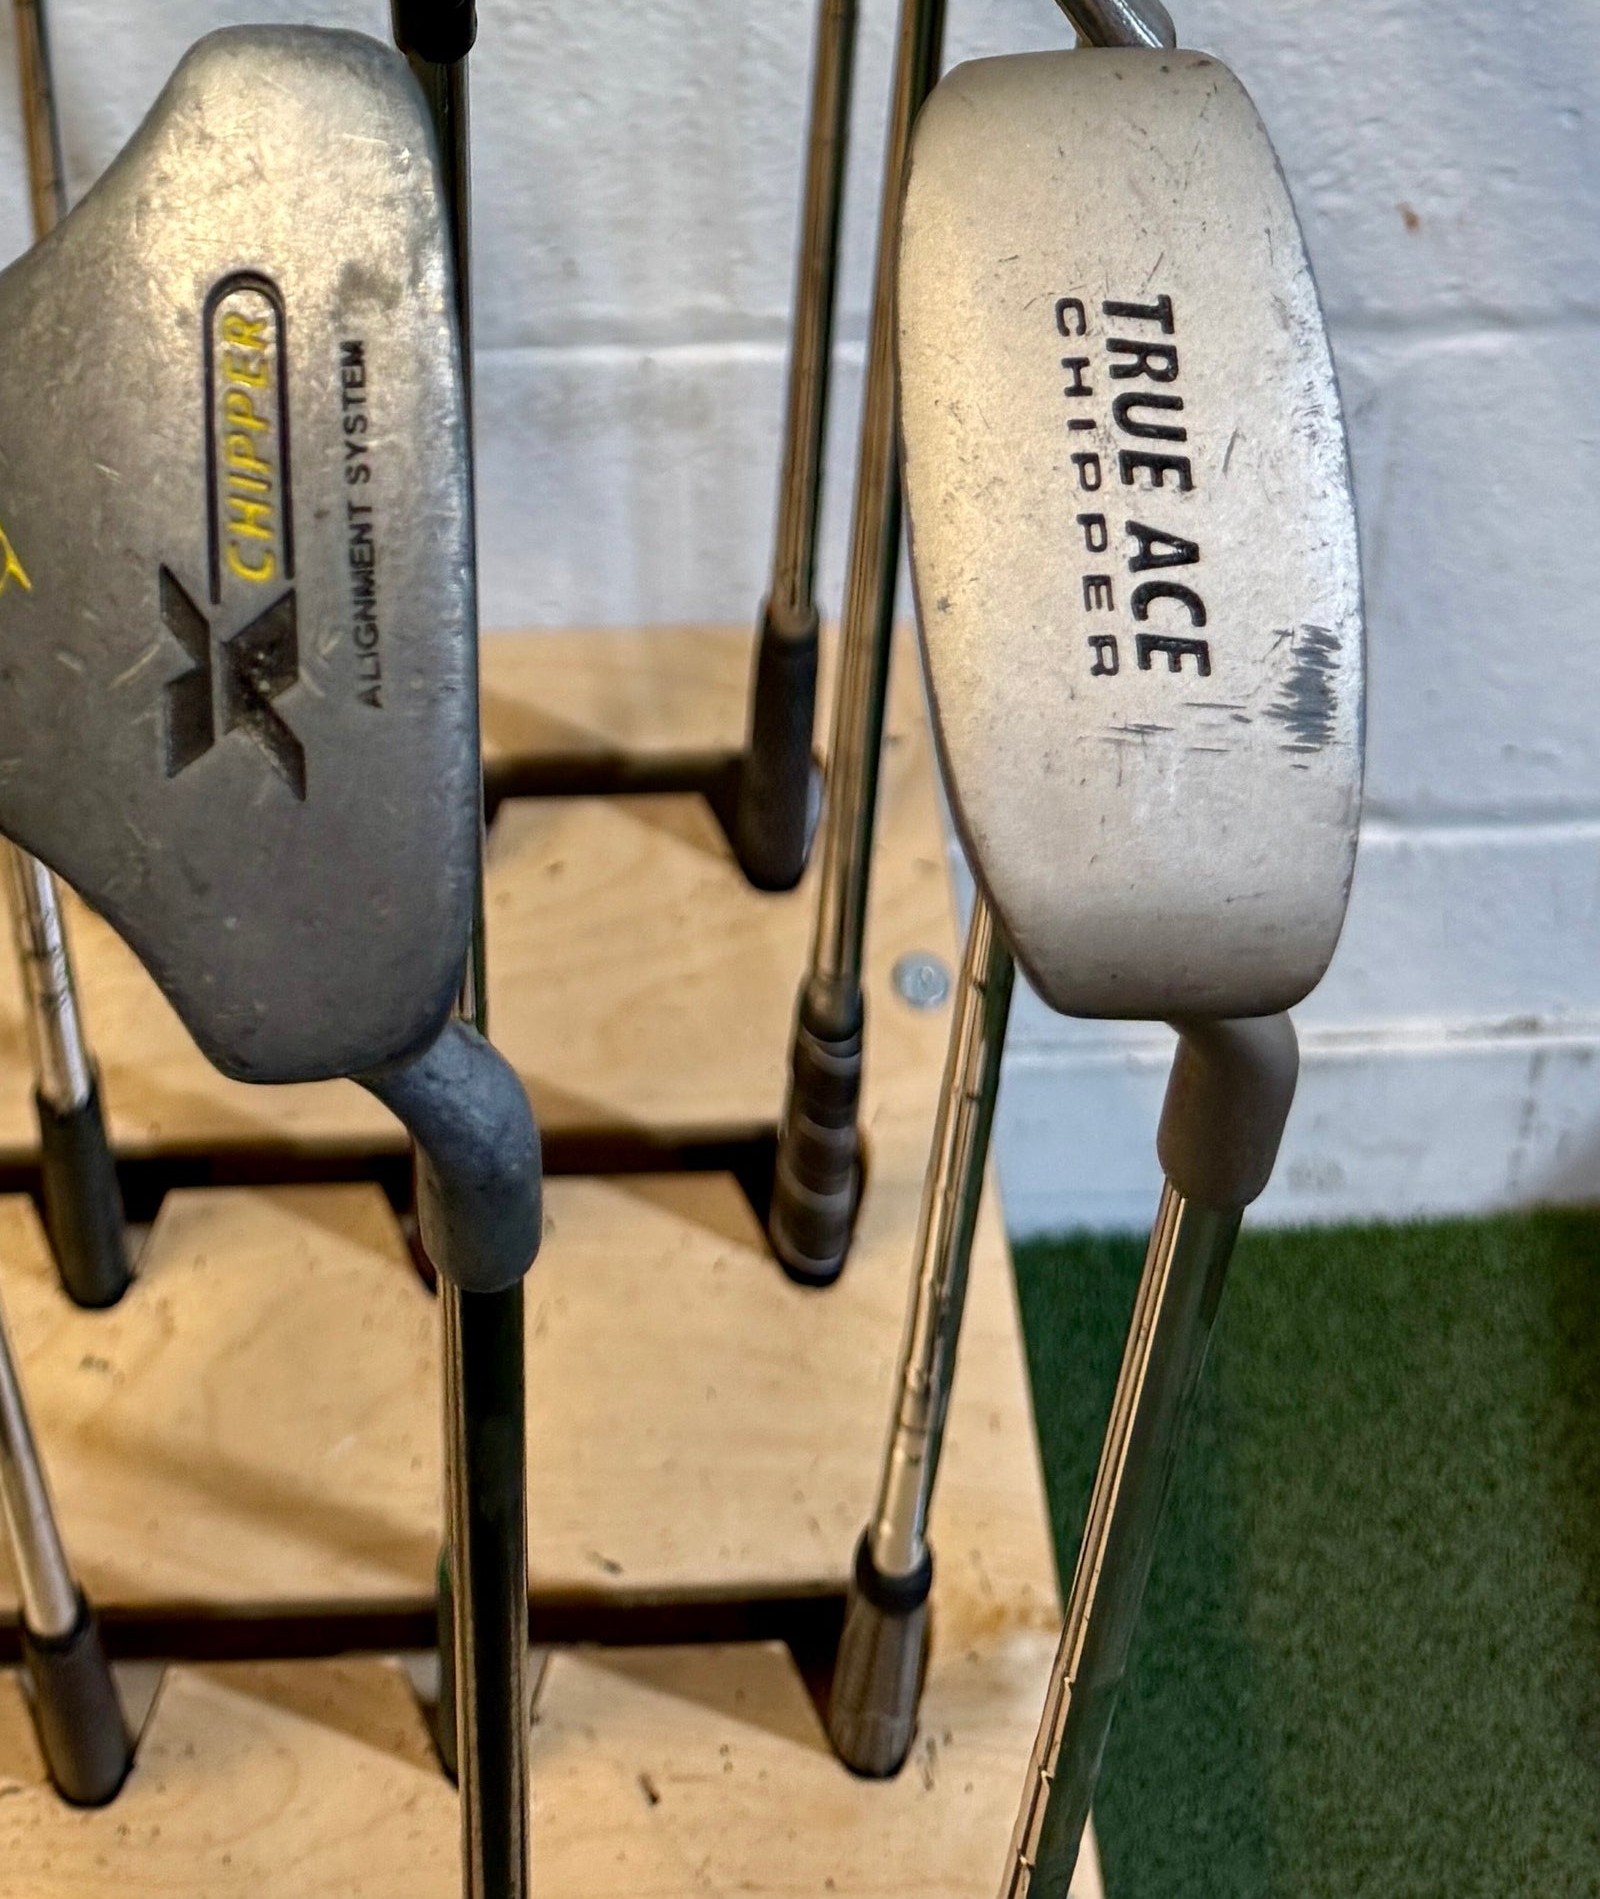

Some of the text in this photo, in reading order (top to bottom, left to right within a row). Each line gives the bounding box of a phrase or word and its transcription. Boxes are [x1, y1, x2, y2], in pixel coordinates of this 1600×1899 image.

[221, 310, 278, 584] CHIPPER
[338, 340, 384, 710] ALIGNMENT SYSTEM
[1055, 297, 1119, 677] CHIPPER
[1102, 294, 1211, 677] TRUE ACE
